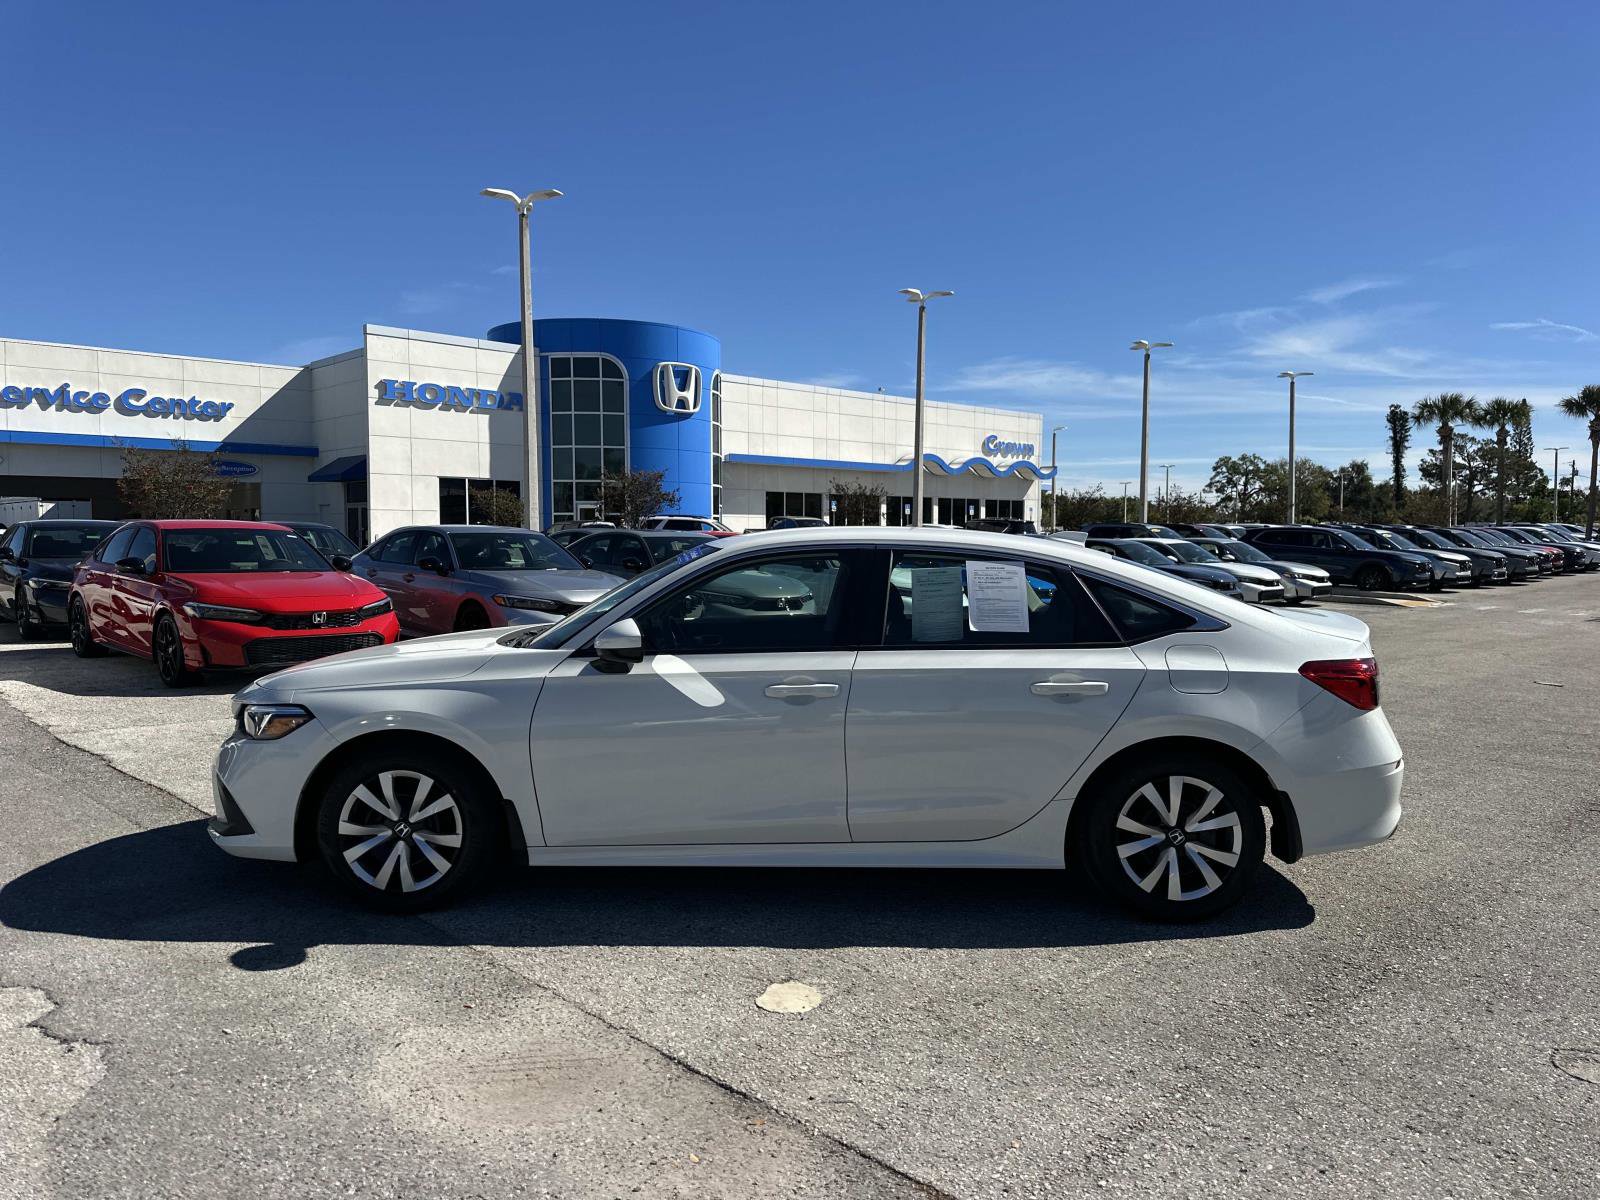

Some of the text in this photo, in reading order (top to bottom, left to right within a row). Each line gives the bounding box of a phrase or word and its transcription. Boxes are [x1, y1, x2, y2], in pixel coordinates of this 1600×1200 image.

[0, 383, 234, 417] ervice Center
[382, 379, 524, 412] HONDA
[984, 434, 1035, 456] Crown
